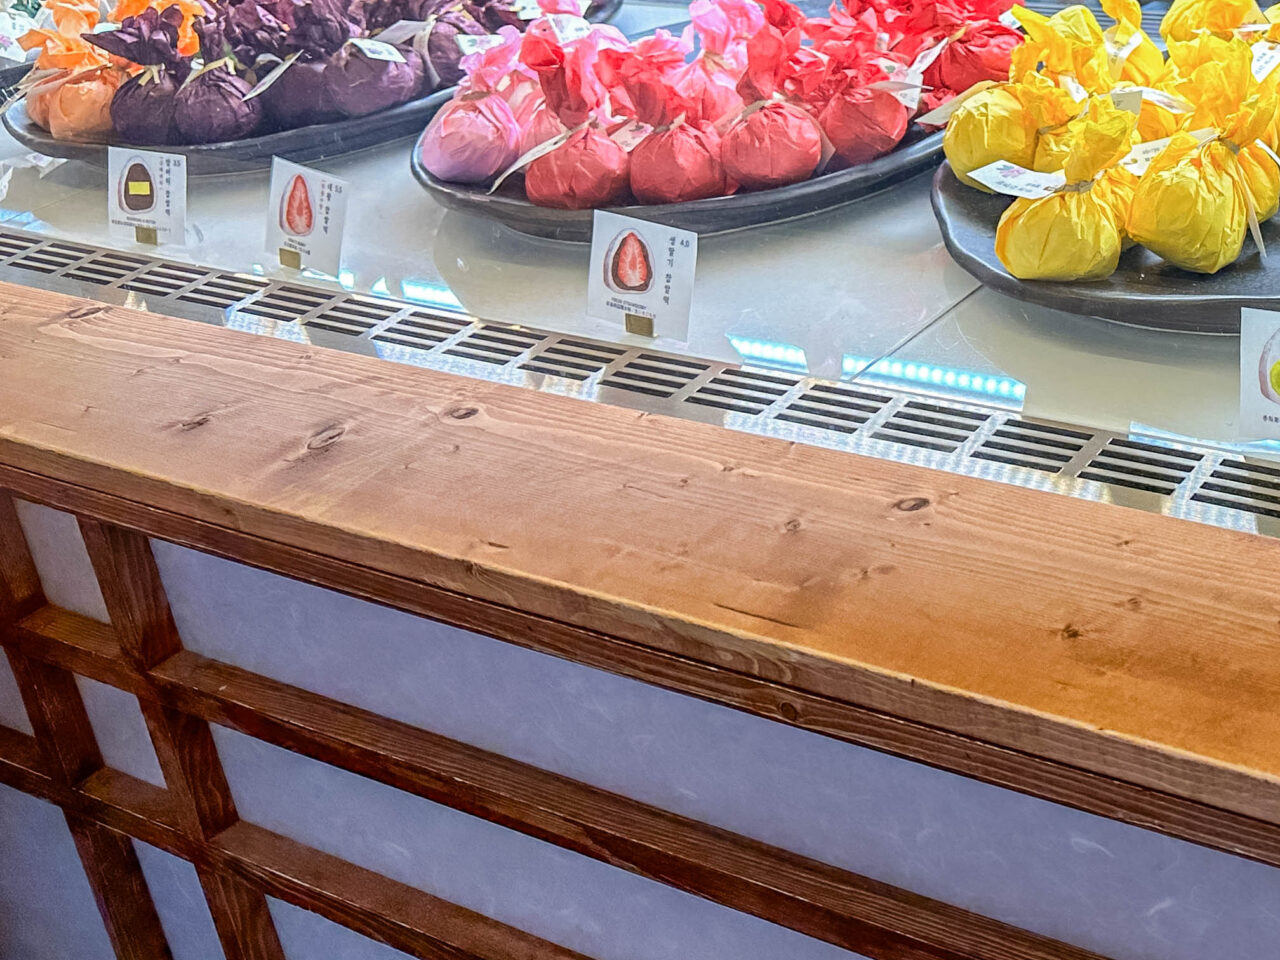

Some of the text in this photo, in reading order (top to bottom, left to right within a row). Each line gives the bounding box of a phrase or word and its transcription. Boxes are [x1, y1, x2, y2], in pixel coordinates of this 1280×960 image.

[680, 239, 690, 248] 4.0
[663, 236, 676, 305] 생딸기 찹쌀떡
